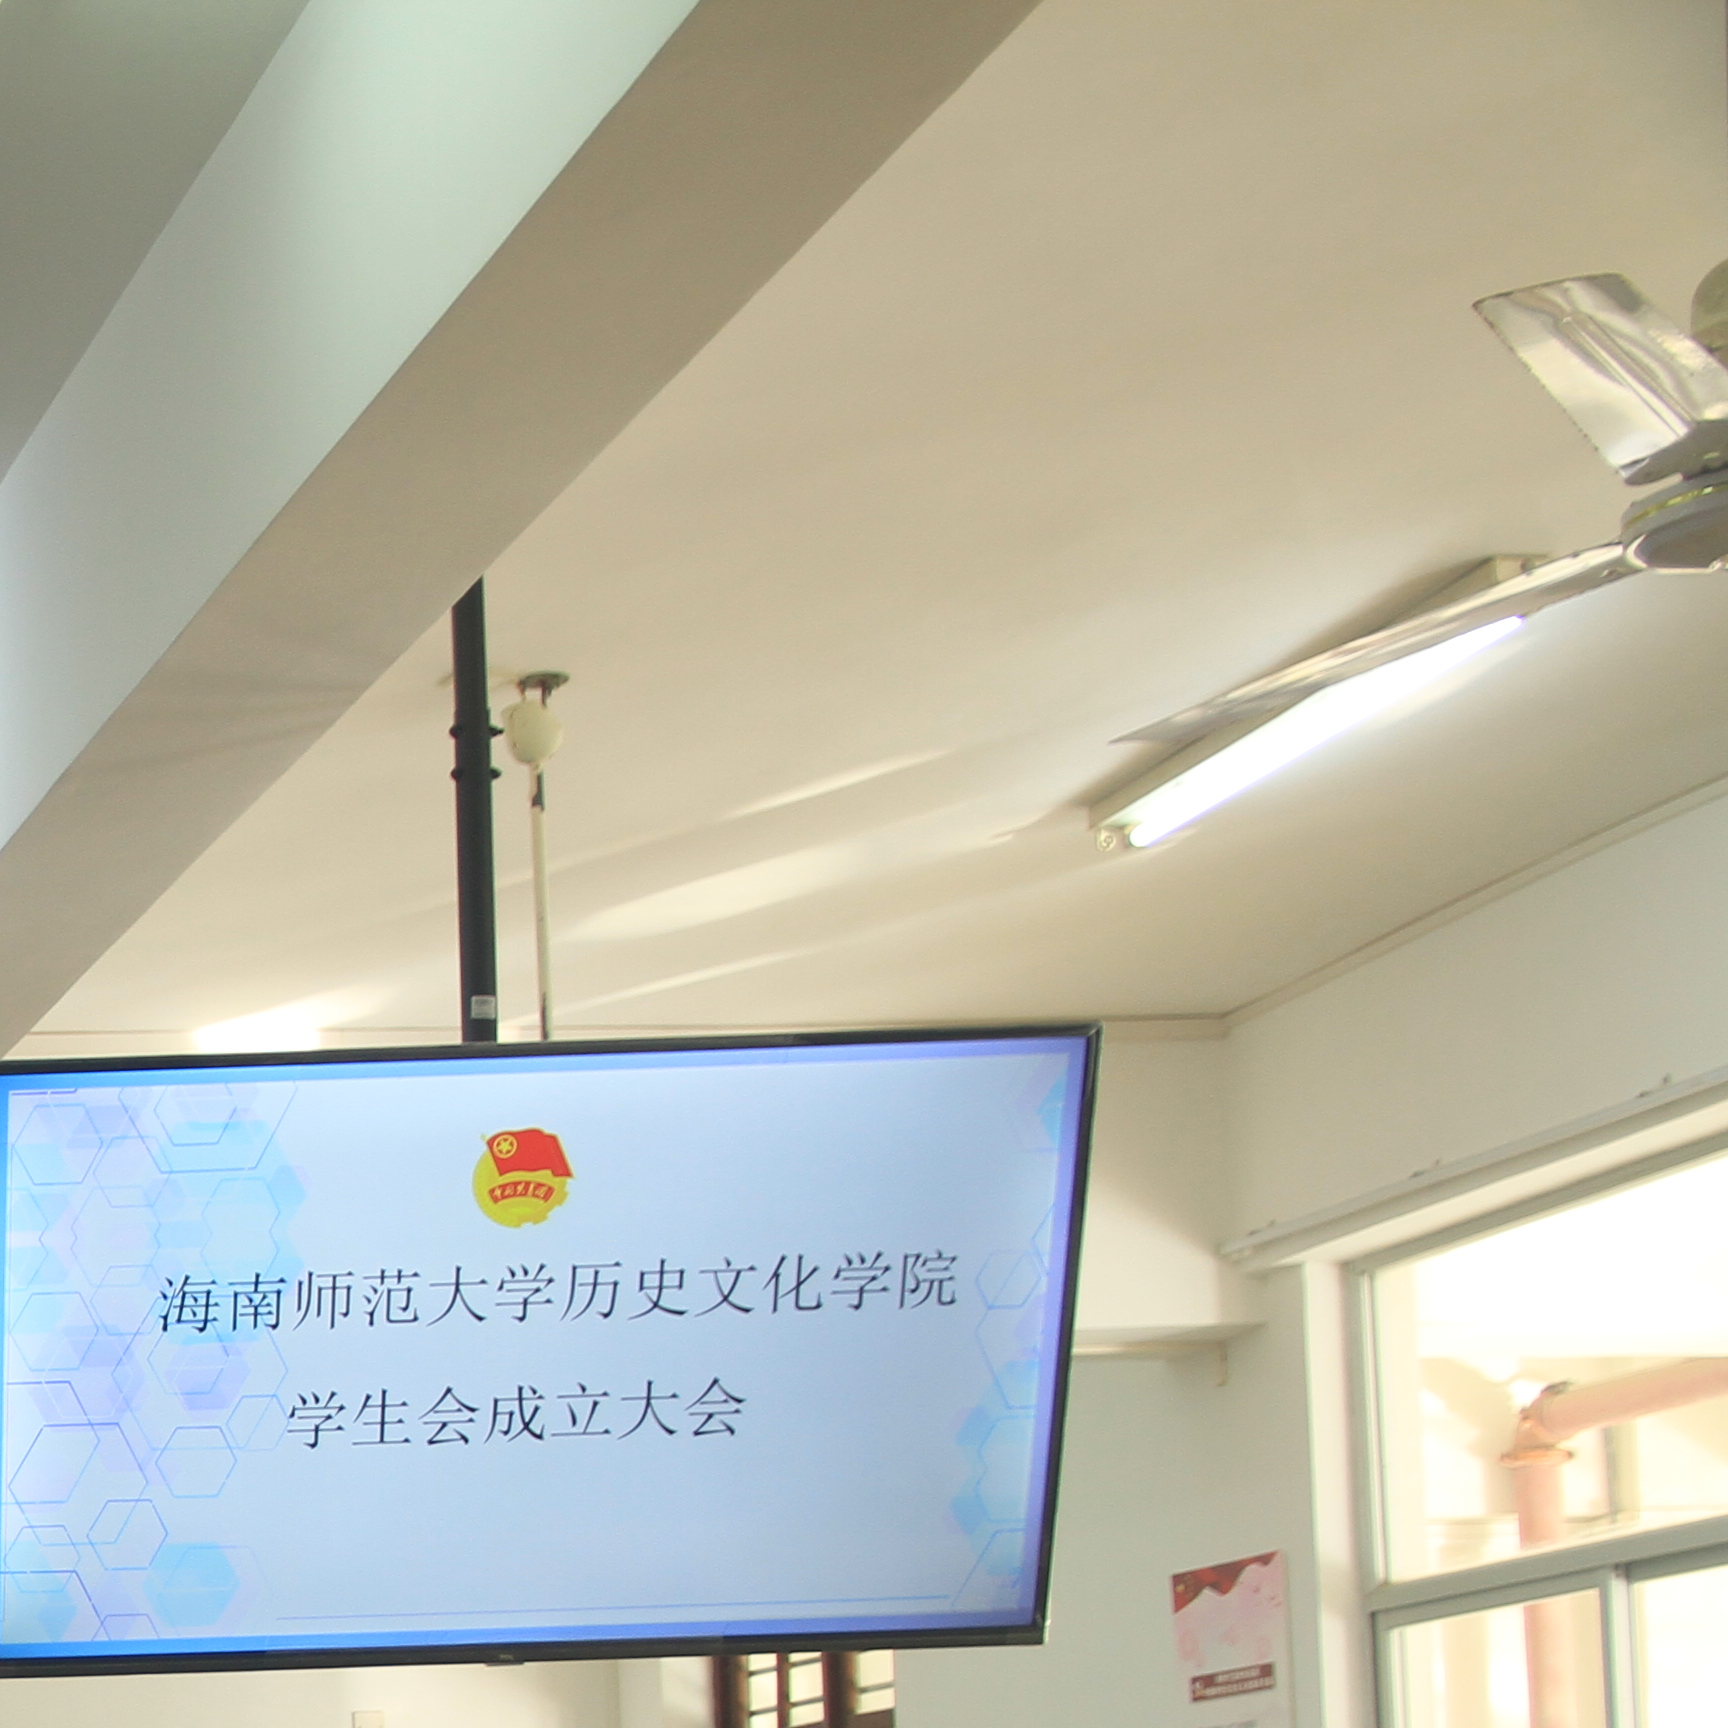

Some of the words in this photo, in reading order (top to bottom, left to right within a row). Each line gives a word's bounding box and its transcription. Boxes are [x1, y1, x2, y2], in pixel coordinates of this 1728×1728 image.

[158, 1250, 957, 1334] 海南师范大学历史文化学院
[287, 1376, 746, 1450] 学生会成立大会
